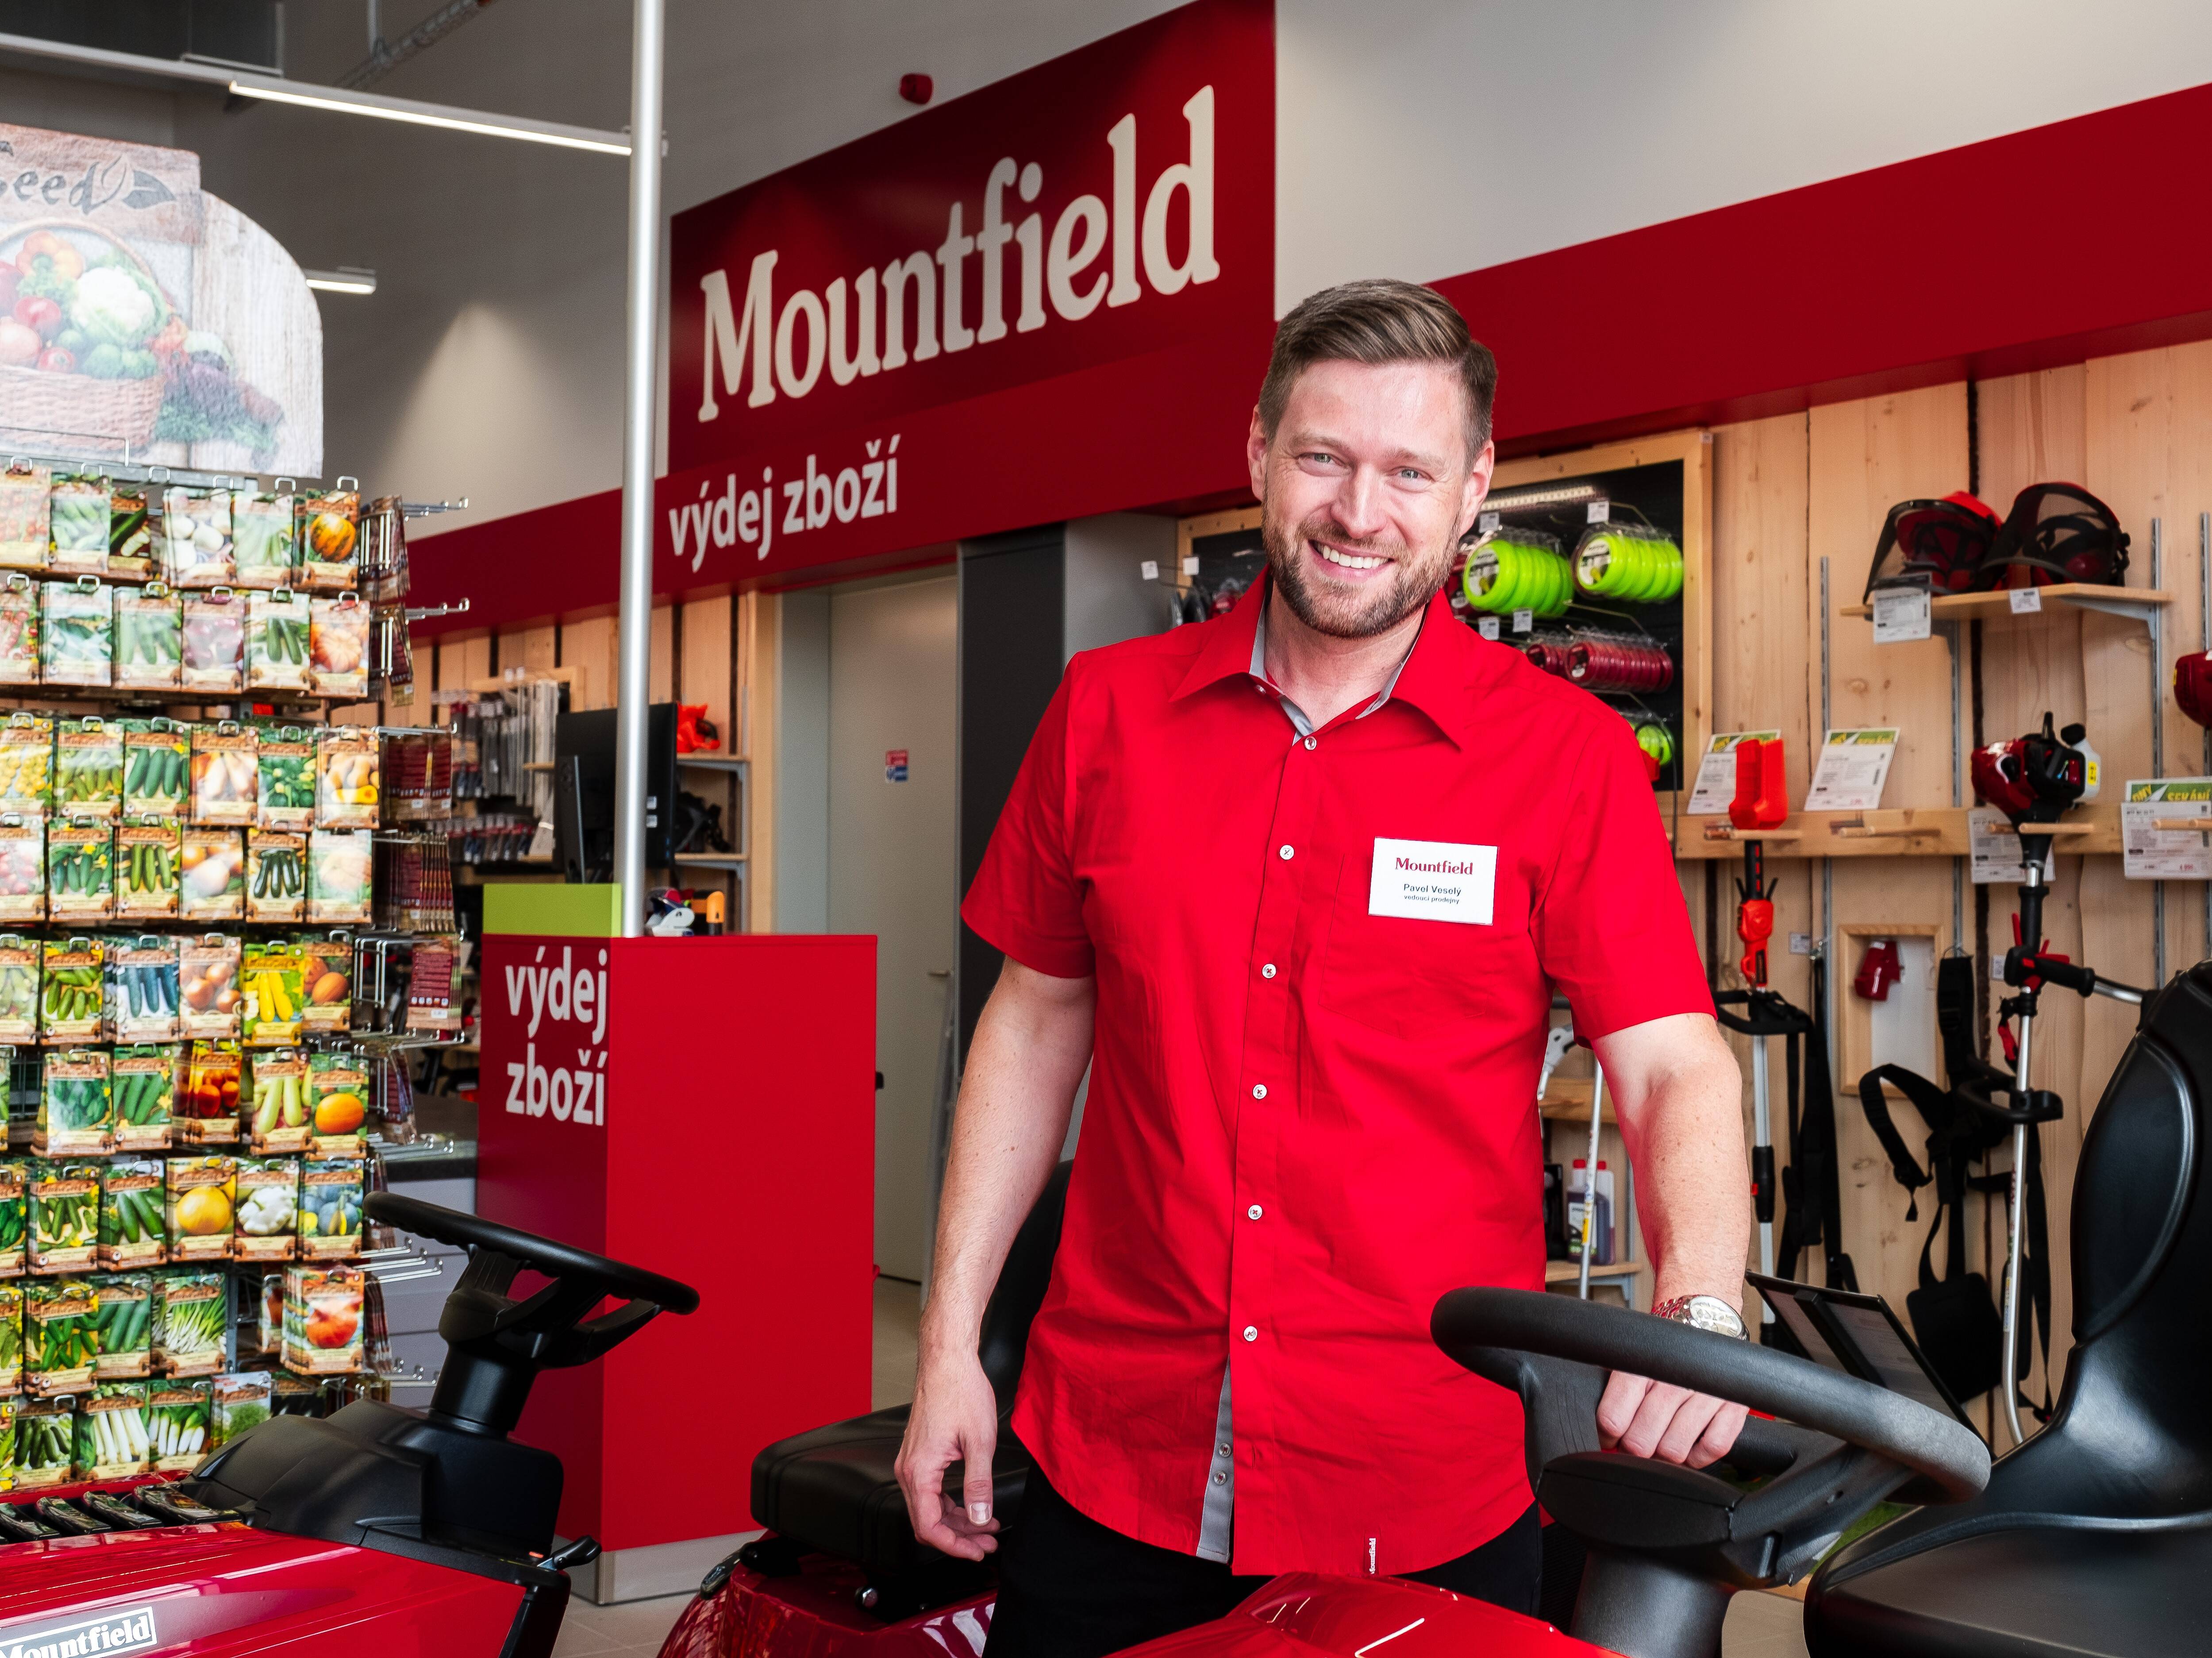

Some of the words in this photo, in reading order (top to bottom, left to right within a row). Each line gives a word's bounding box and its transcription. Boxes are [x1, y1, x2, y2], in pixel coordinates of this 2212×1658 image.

[0, 155, 127, 215] eed
[698, 85, 1220, 423] Mountfield
[669, 467, 773, 572] výdej
[783, 434, 901, 534] zboží
[1395, 857, 1473, 875] Mountfield
[505, 945, 607, 1045] výdej
[505, 1042, 608, 1126] zboží
